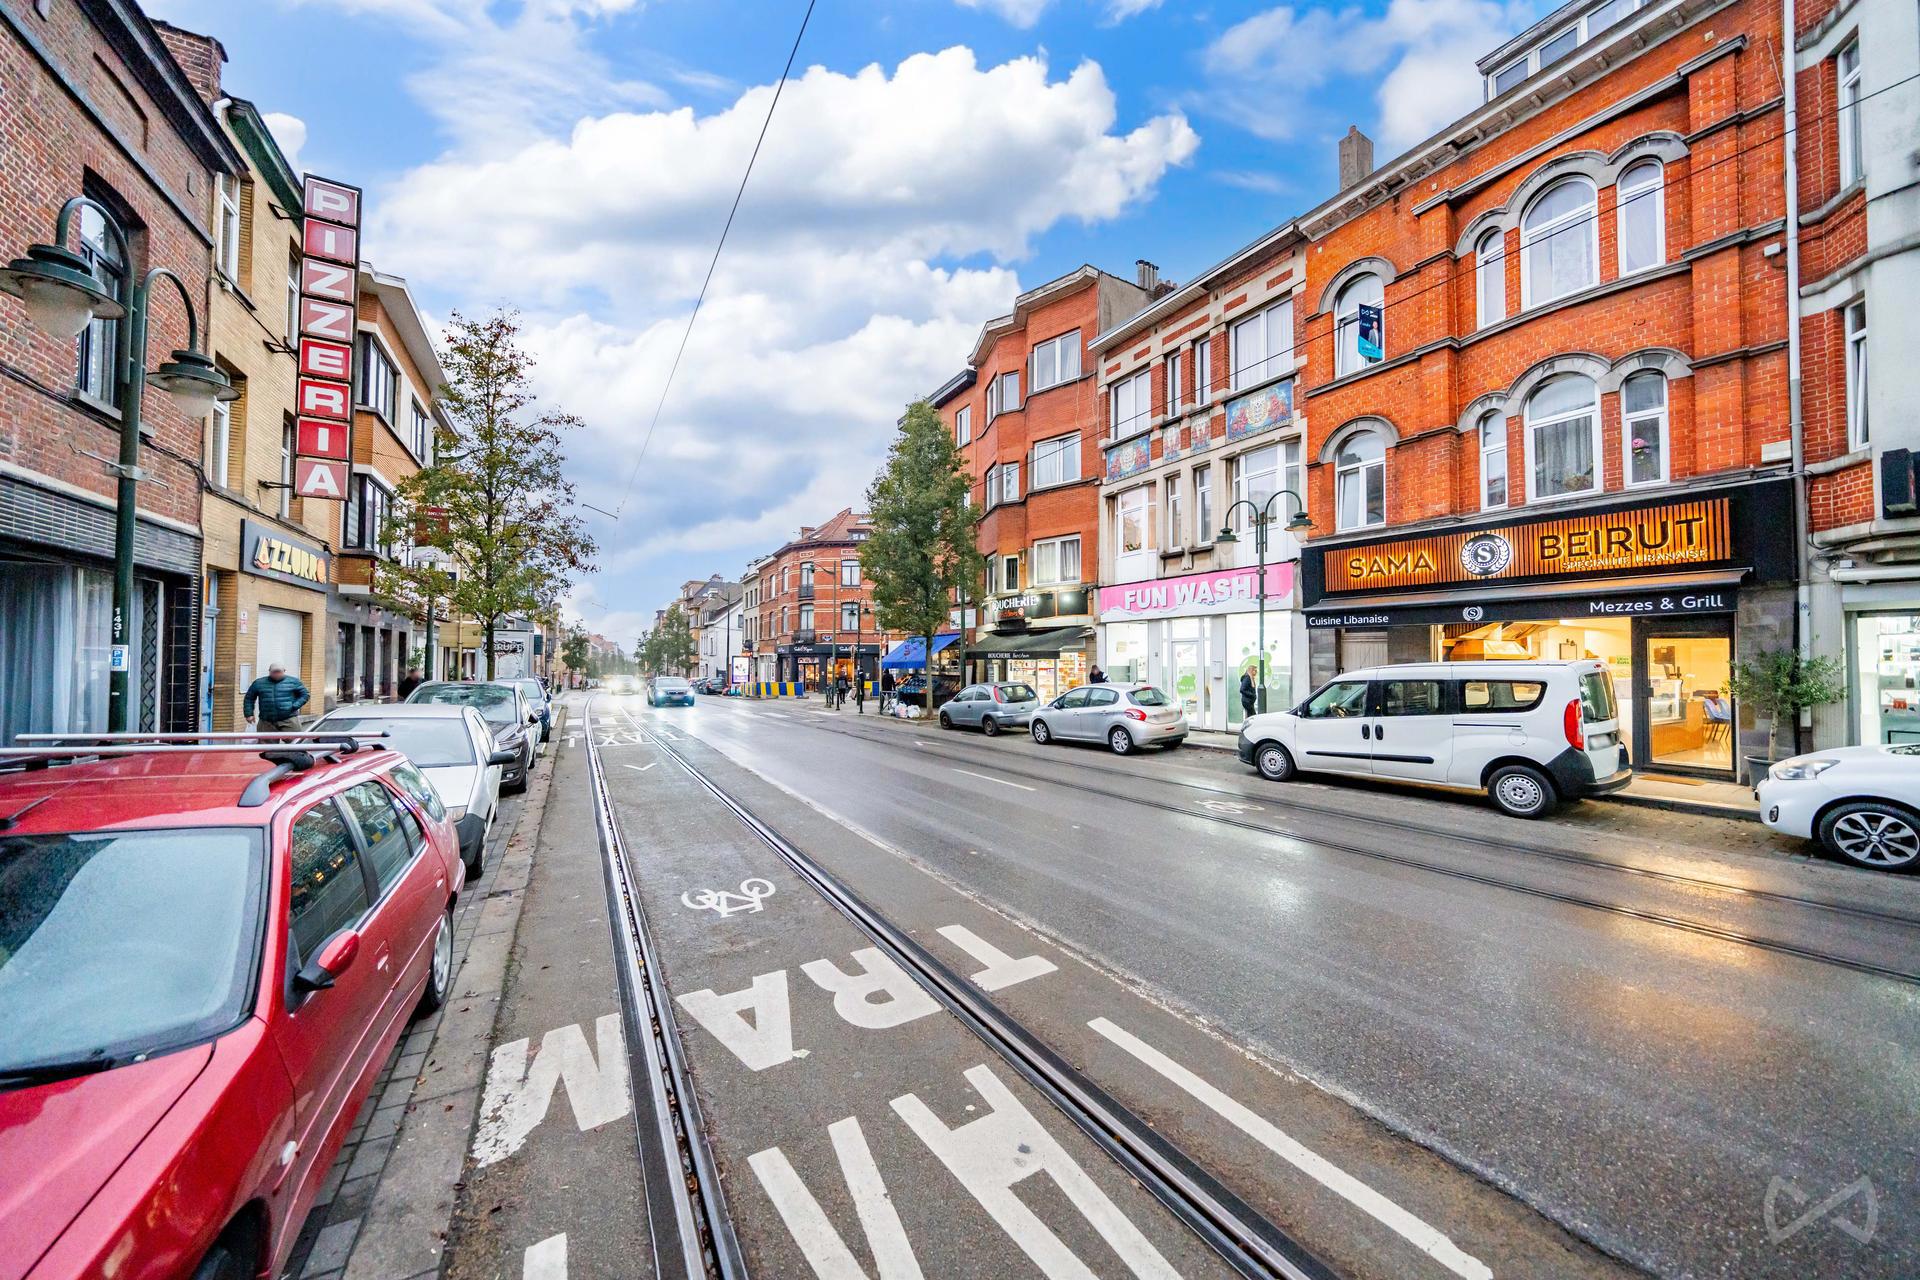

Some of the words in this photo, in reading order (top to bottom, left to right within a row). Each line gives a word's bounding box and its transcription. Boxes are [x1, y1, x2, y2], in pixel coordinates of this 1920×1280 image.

[303, 187, 350, 495] PIZZERIA
[1350, 551, 1435, 579] SAMA
[1539, 517, 1704, 560] BEIRUT
[1635, 548, 1707, 564] LIBANAISE
[1125, 586, 1167, 610] FUN
[1174, 576, 1252, 605] WASH
[1590, 600, 1653, 613] Mezzes
[1661, 597, 1674, 610] &
[1681, 595, 1724, 608] Grill
[114, 608, 122, 638] 1431
[1309, 616, 1341, 625] Cuisine
[1343, 614, 1389, 625] Libanaise
[472, 924, 1058, 1167] TRAM
